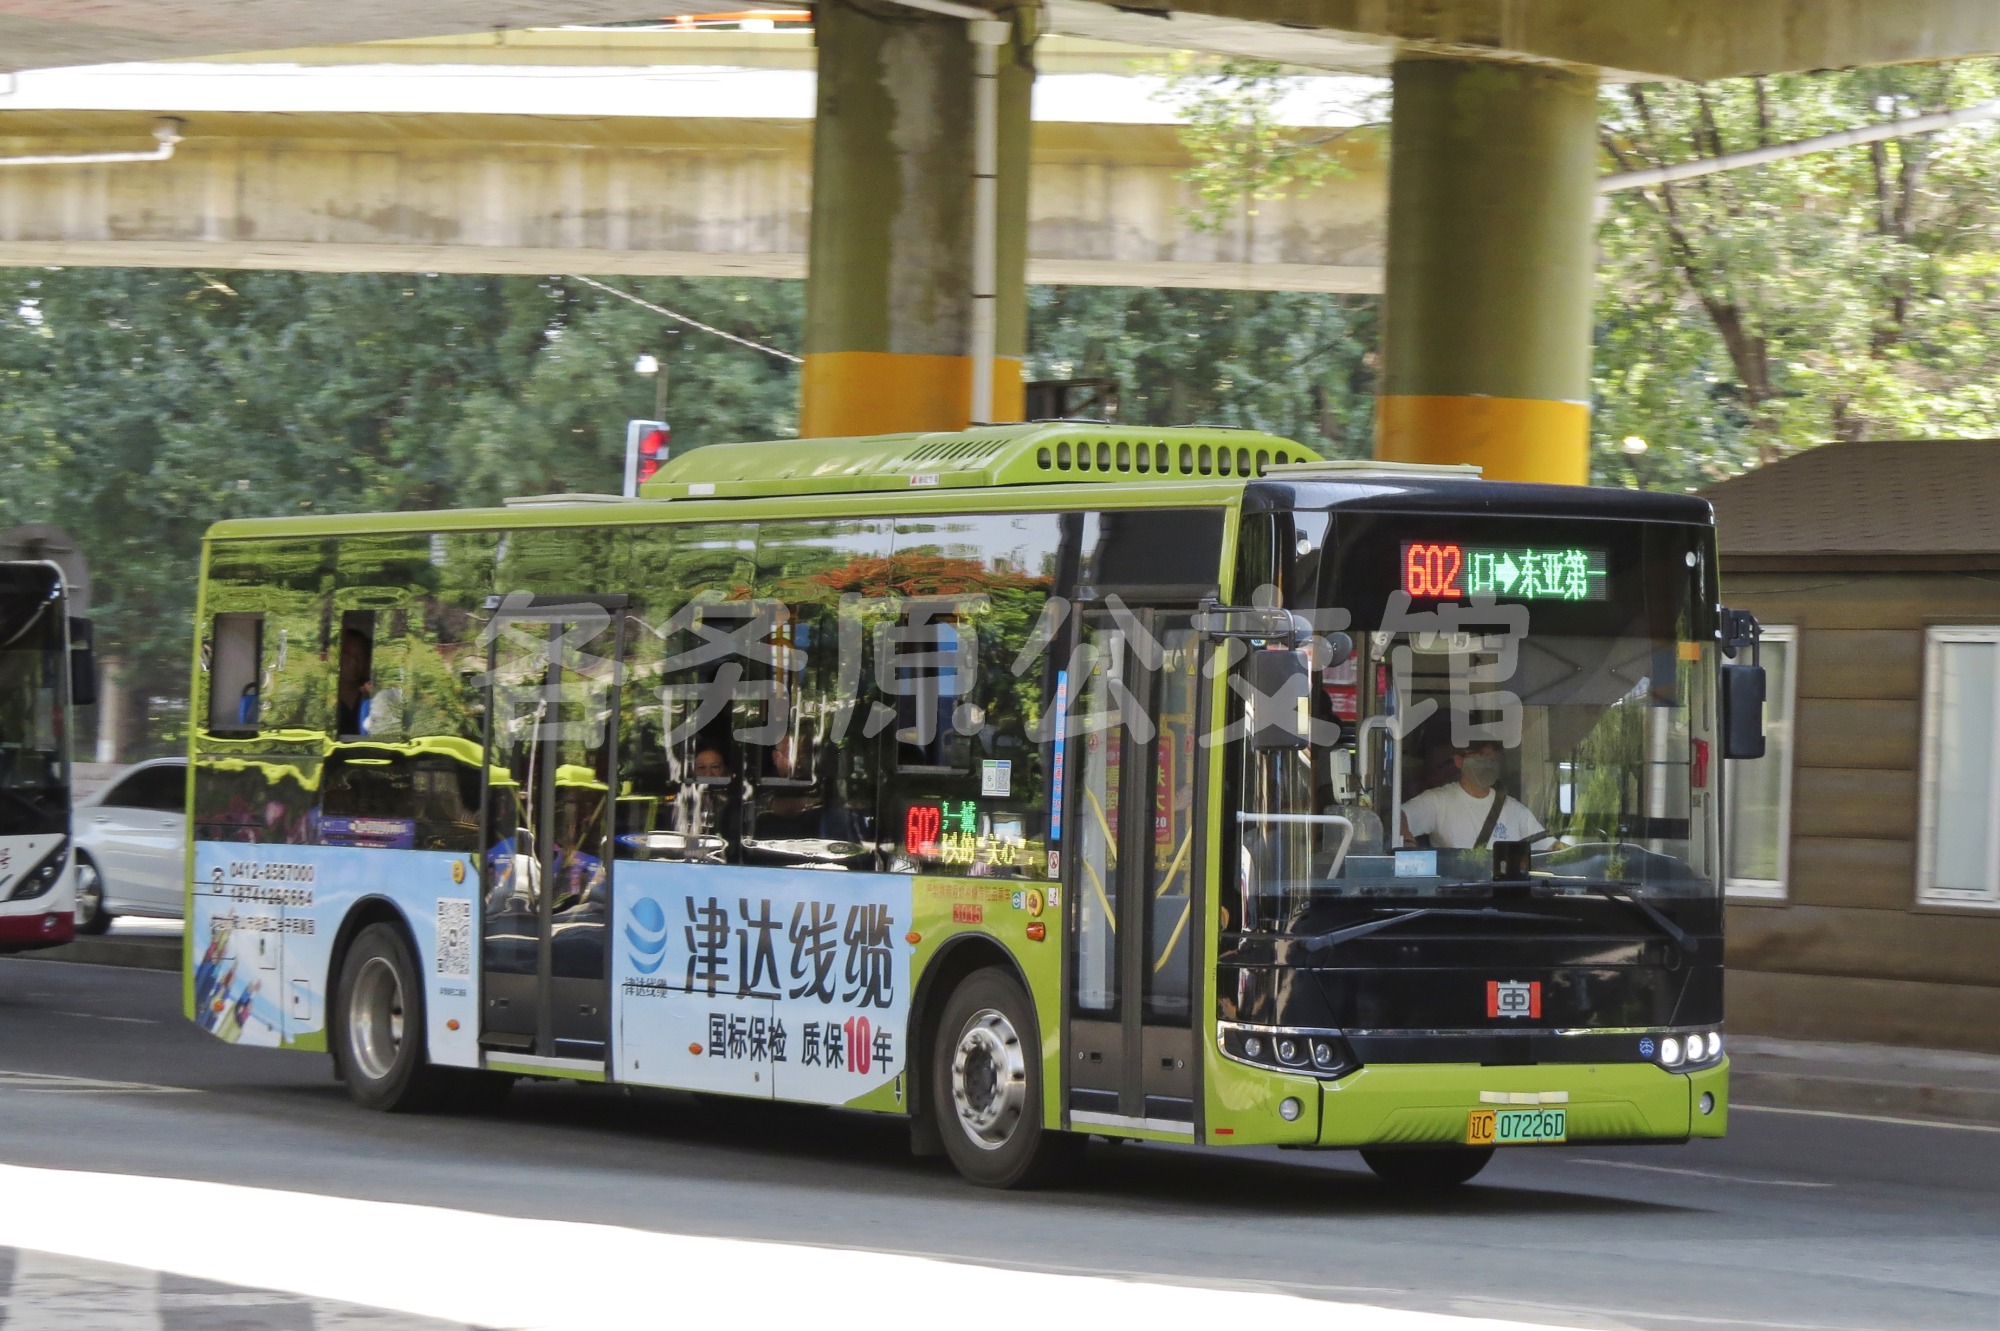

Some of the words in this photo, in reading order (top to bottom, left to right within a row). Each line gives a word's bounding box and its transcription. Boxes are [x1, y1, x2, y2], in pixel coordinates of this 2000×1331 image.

[1408, 544, 1461, 597] 602
[906, 806, 941, 855] 602
[684, 896, 895, 1009] 津达线缆
[623, 976, 668, 999] 津达线缆
[708, 1012, 787, 1064] 国标保检
[801, 1015, 894, 1075] 质保10年
